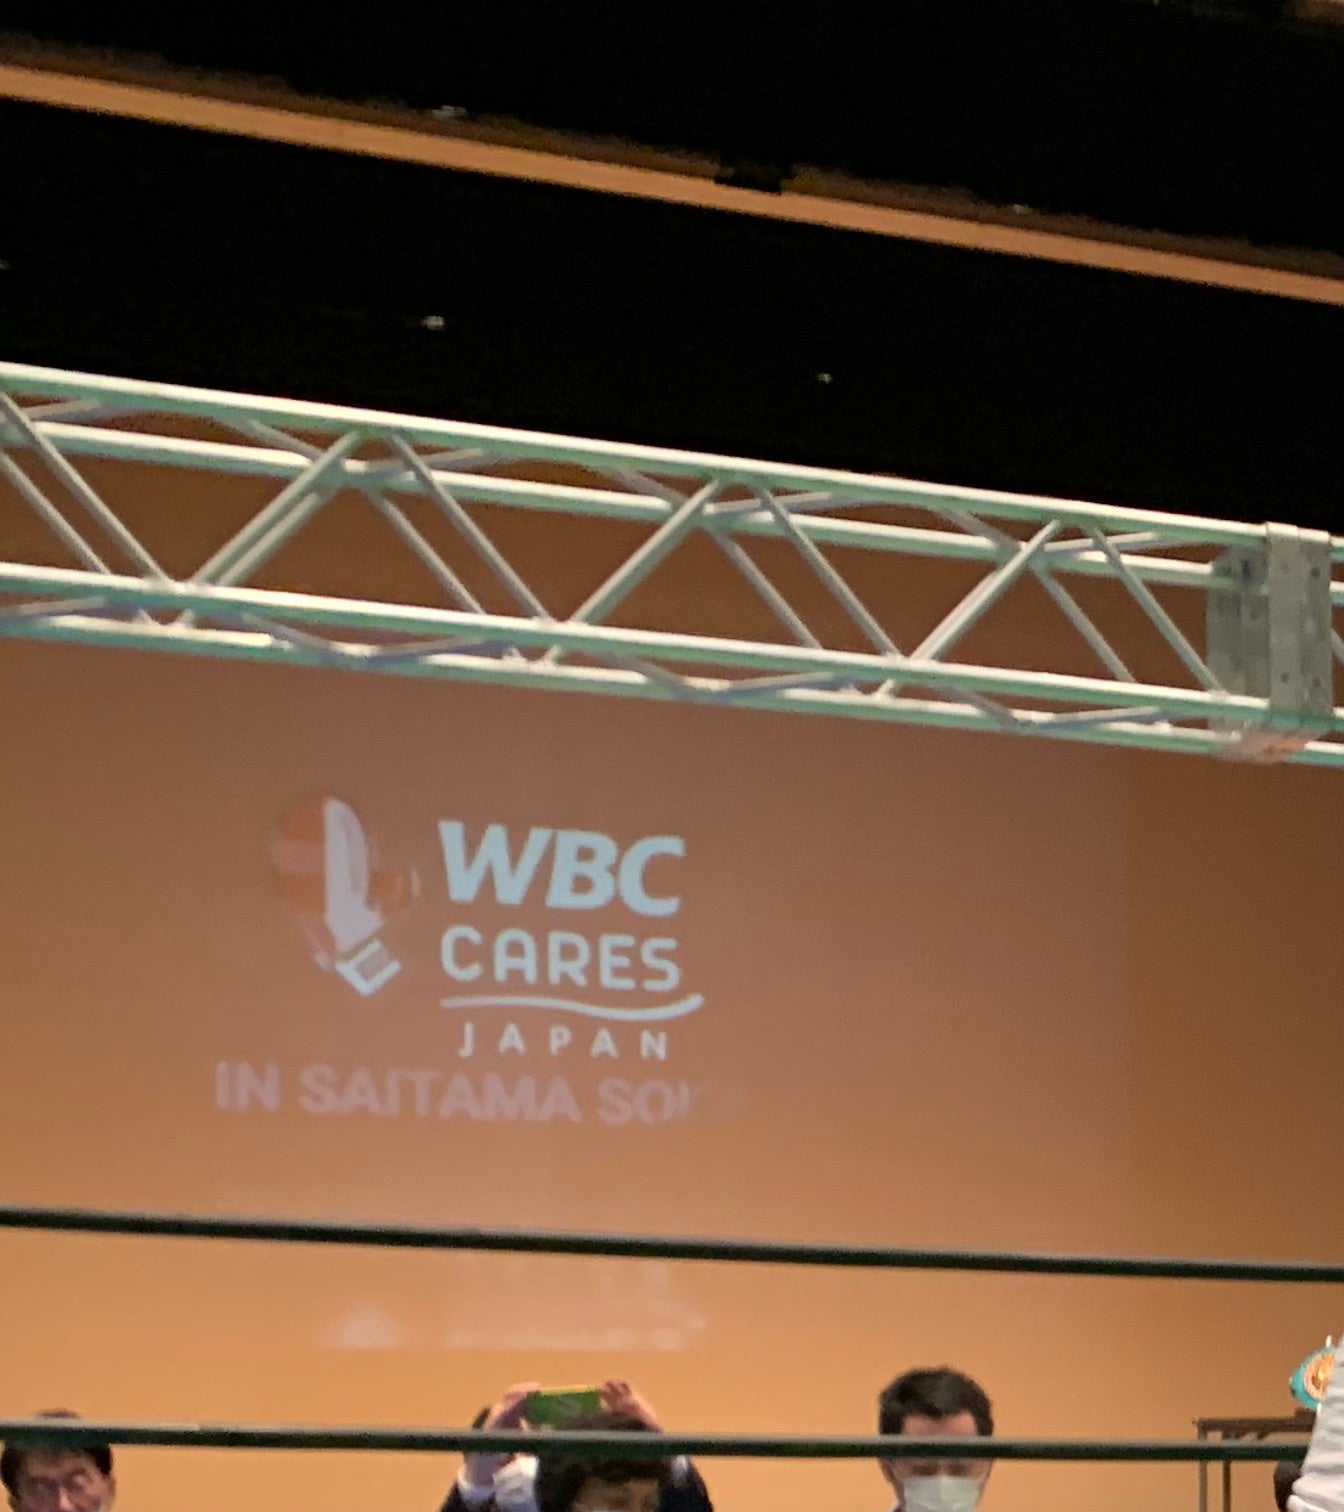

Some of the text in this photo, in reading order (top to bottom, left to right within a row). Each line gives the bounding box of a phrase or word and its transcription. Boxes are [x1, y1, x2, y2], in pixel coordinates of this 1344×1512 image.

[437, 819, 686, 917] WBC
[440, 924, 681, 992] CARES
[457, 1021, 668, 1061] JAPAN
[215, 1060, 281, 1112] IN
[299, 1063, 582, 1124] SAITAMA
